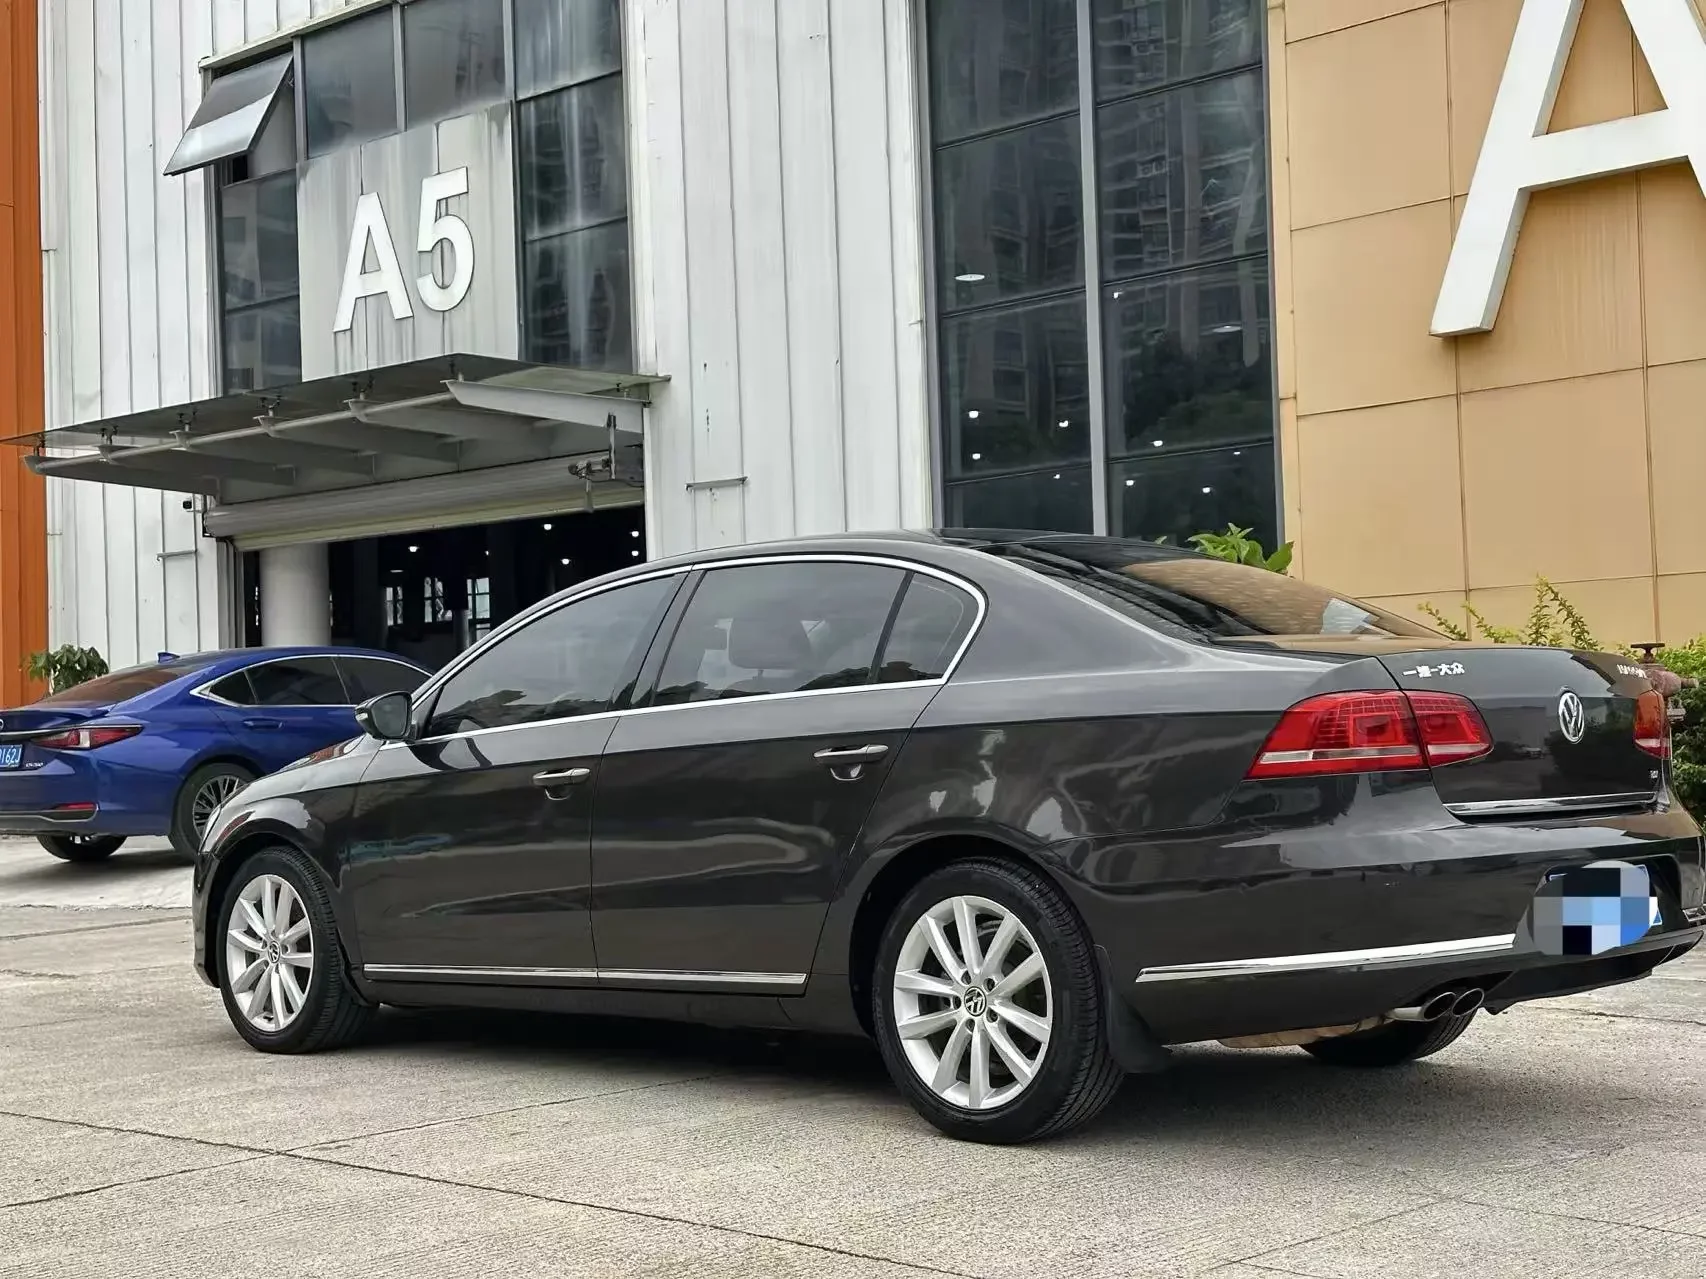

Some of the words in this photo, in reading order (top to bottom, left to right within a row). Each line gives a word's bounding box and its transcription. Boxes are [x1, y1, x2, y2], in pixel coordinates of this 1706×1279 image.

[333, 166, 475, 332] A5
[1429, 0, 1706, 336] A
[0, 747, 22, 764] 162J
